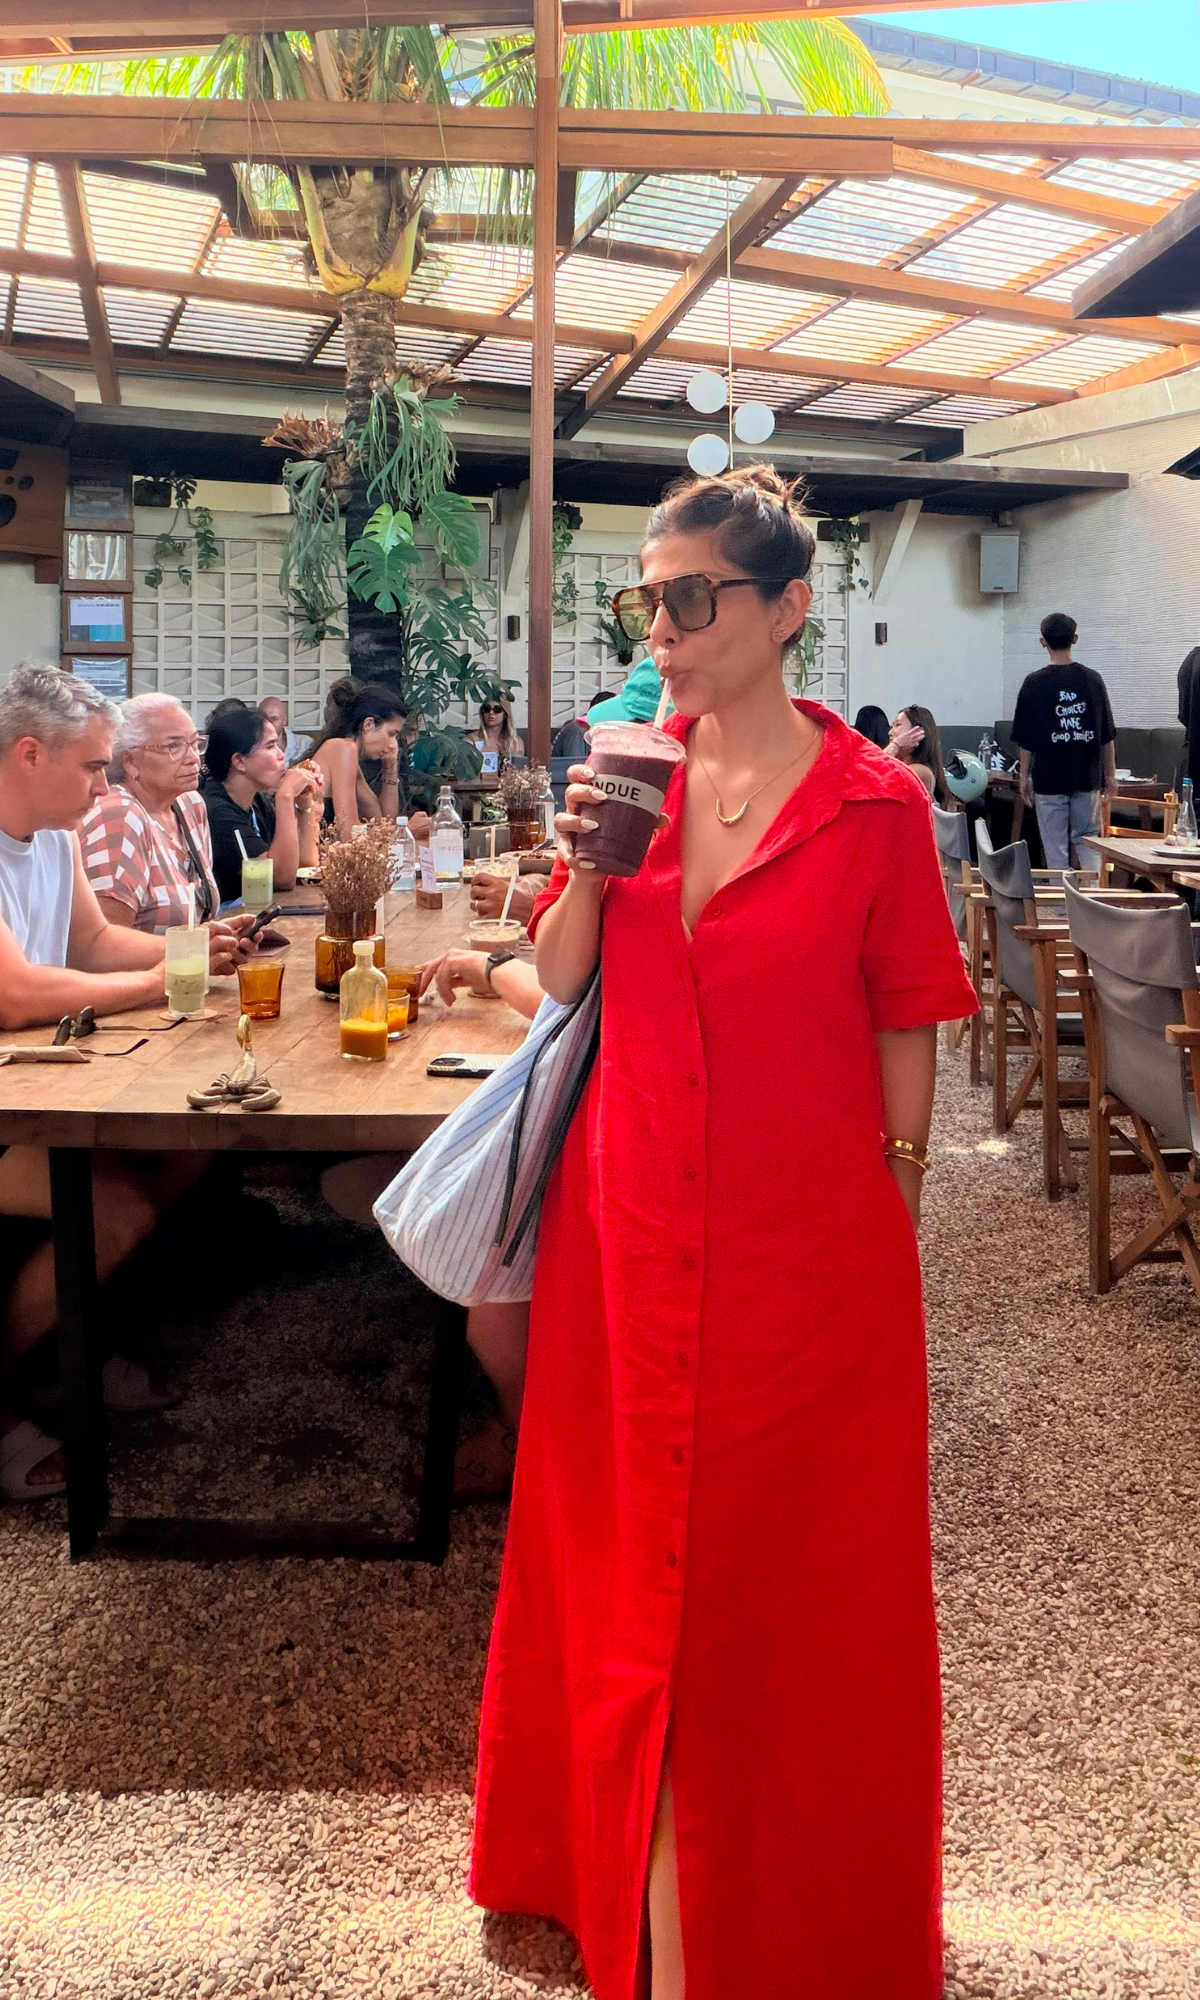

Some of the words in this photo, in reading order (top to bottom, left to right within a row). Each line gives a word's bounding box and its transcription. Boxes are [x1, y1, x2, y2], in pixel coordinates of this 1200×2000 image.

[1059, 691, 1077, 702] BAD
[1055, 702, 1087, 717] CHOICES
[1060, 717, 1082, 730] MAKE
[1051, 732, 1071, 743] GOOD
[589, 781, 641, 801] NDUE
